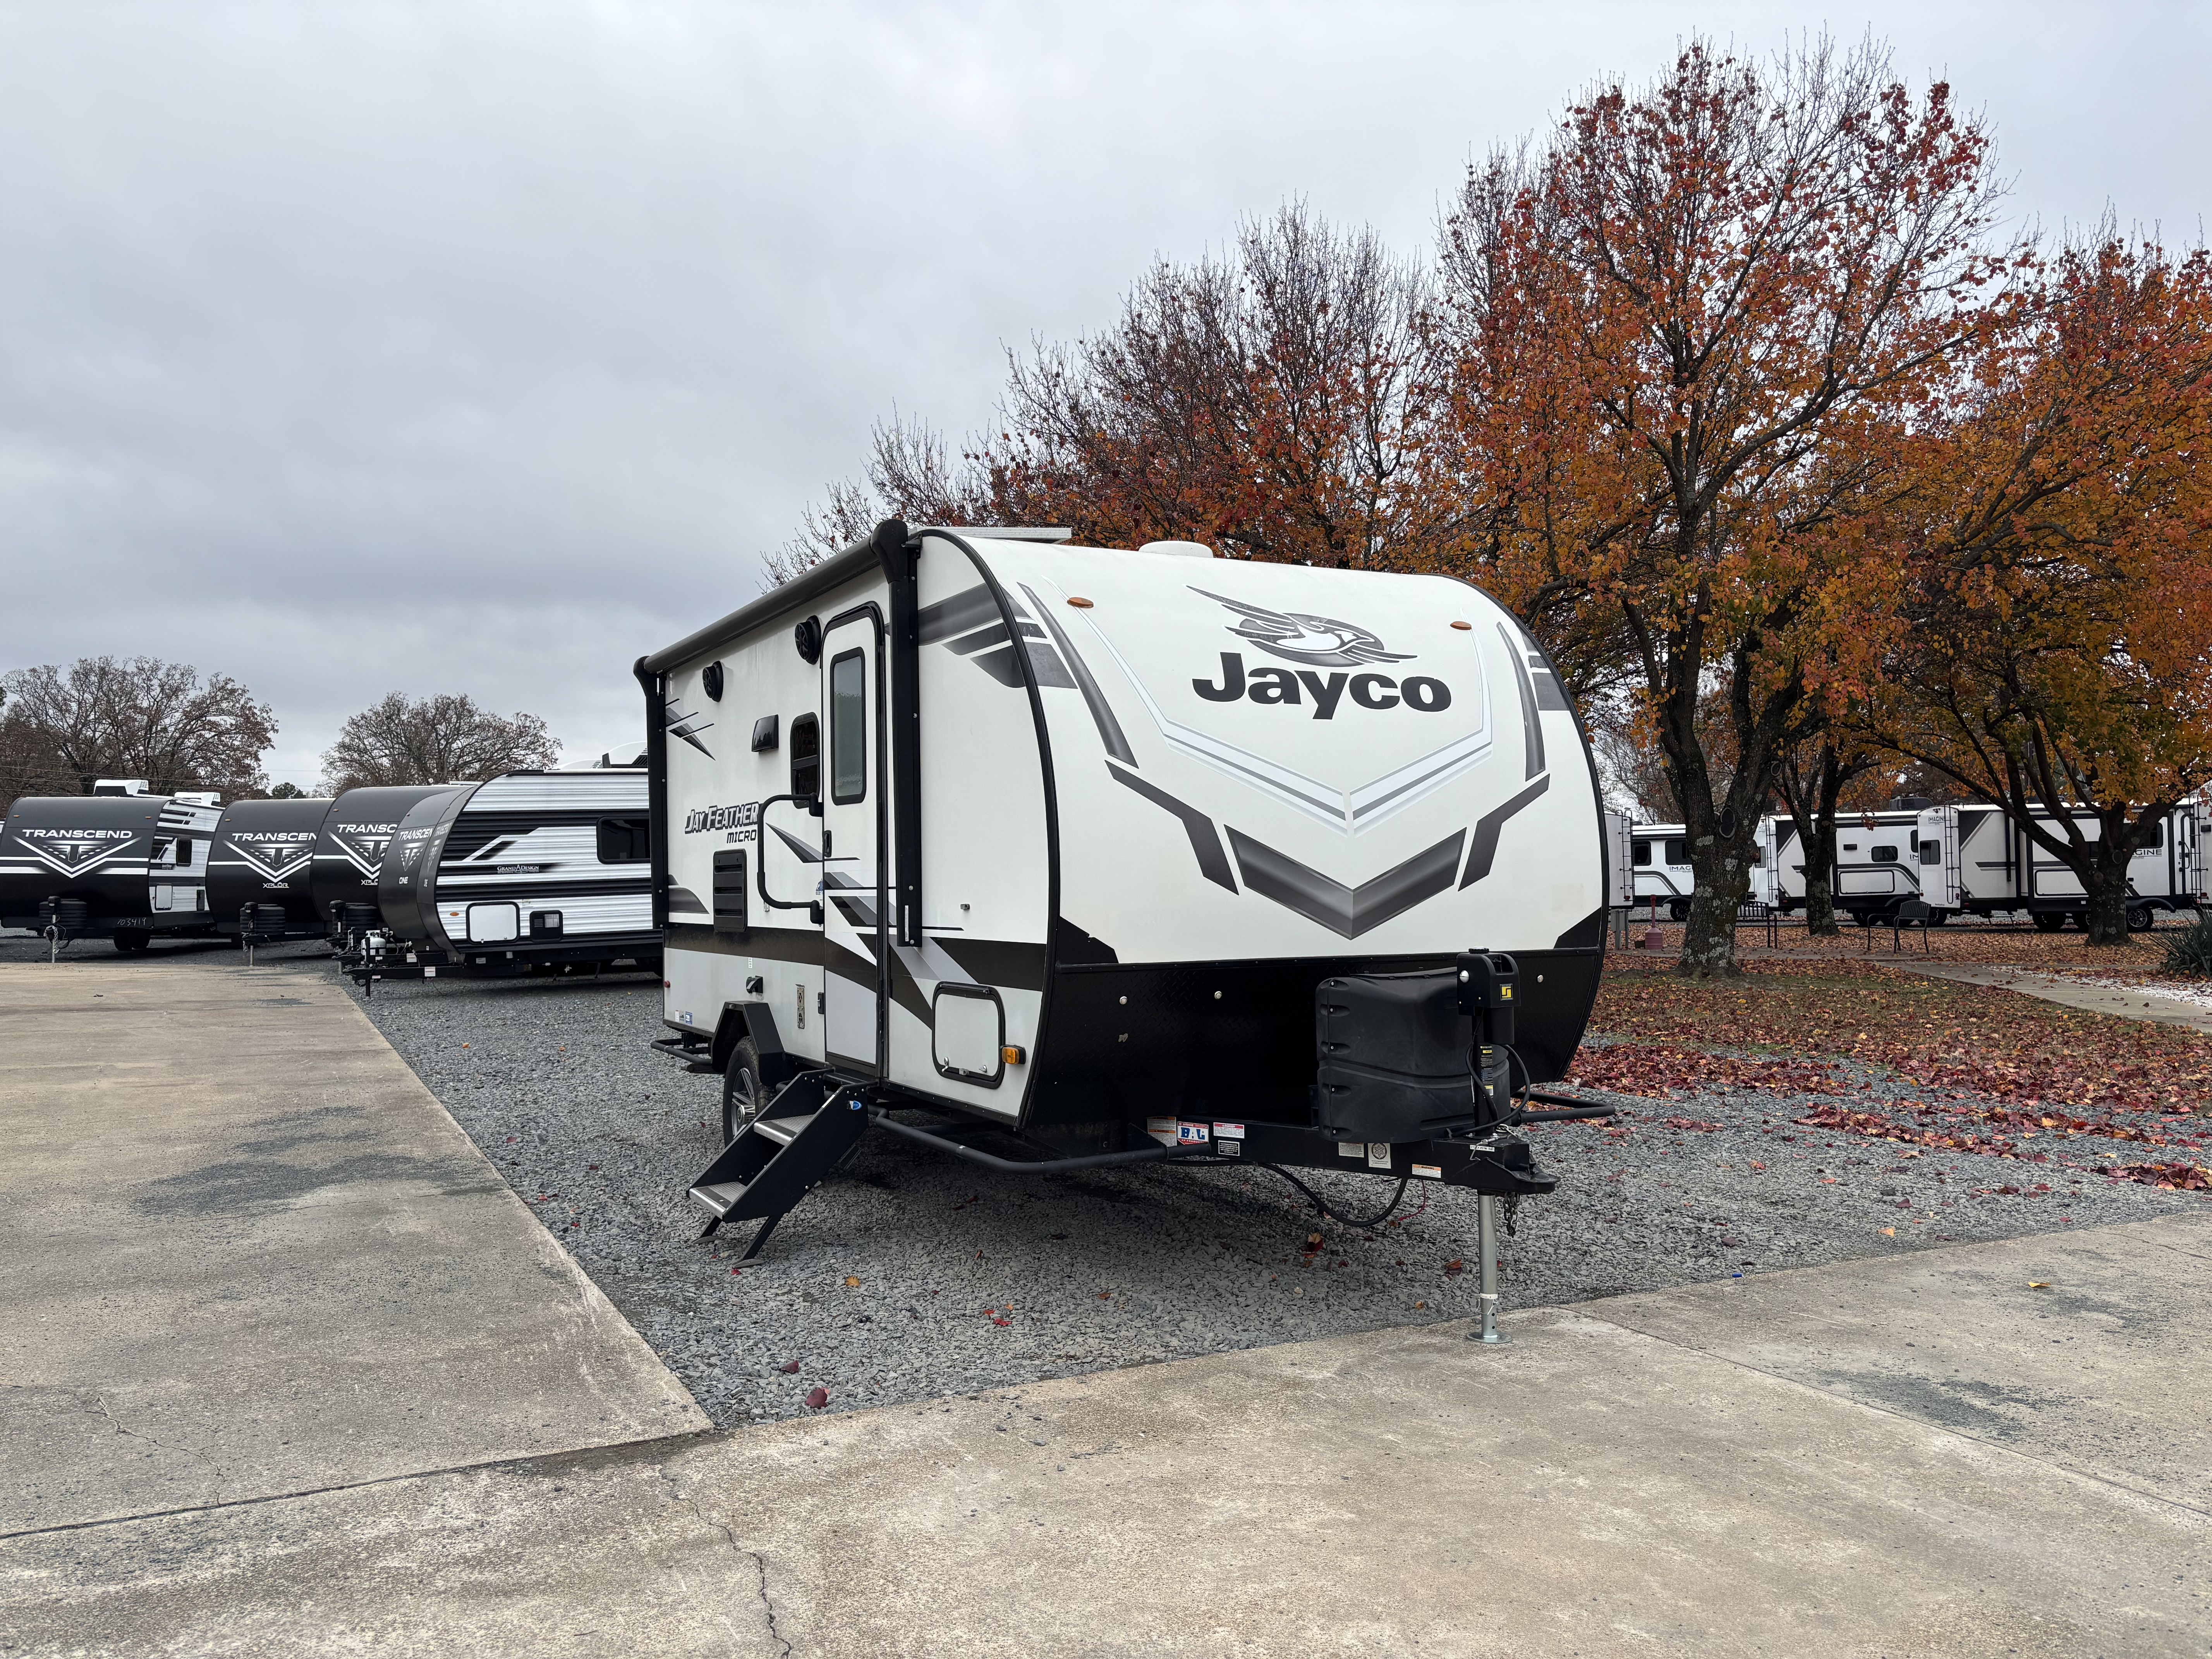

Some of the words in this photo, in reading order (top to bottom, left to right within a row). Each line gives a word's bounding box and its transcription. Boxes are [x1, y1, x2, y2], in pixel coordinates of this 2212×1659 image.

[1192, 652, 1451, 720] Jayco
[685, 809, 706, 834] JAY
[706, 801, 759, 831] FEATHER
[22, 830, 132, 838] TRANSCEND
[337, 824, 398, 833] TRANSC
[398, 828, 433, 841] TRANSCEN
[232, 833, 317, 841] TRANSCEN
[726, 830, 757, 843] MICRO
[117, 917, 146, 926] 103419
[1181, 1127, 1205, 1140] BAL
